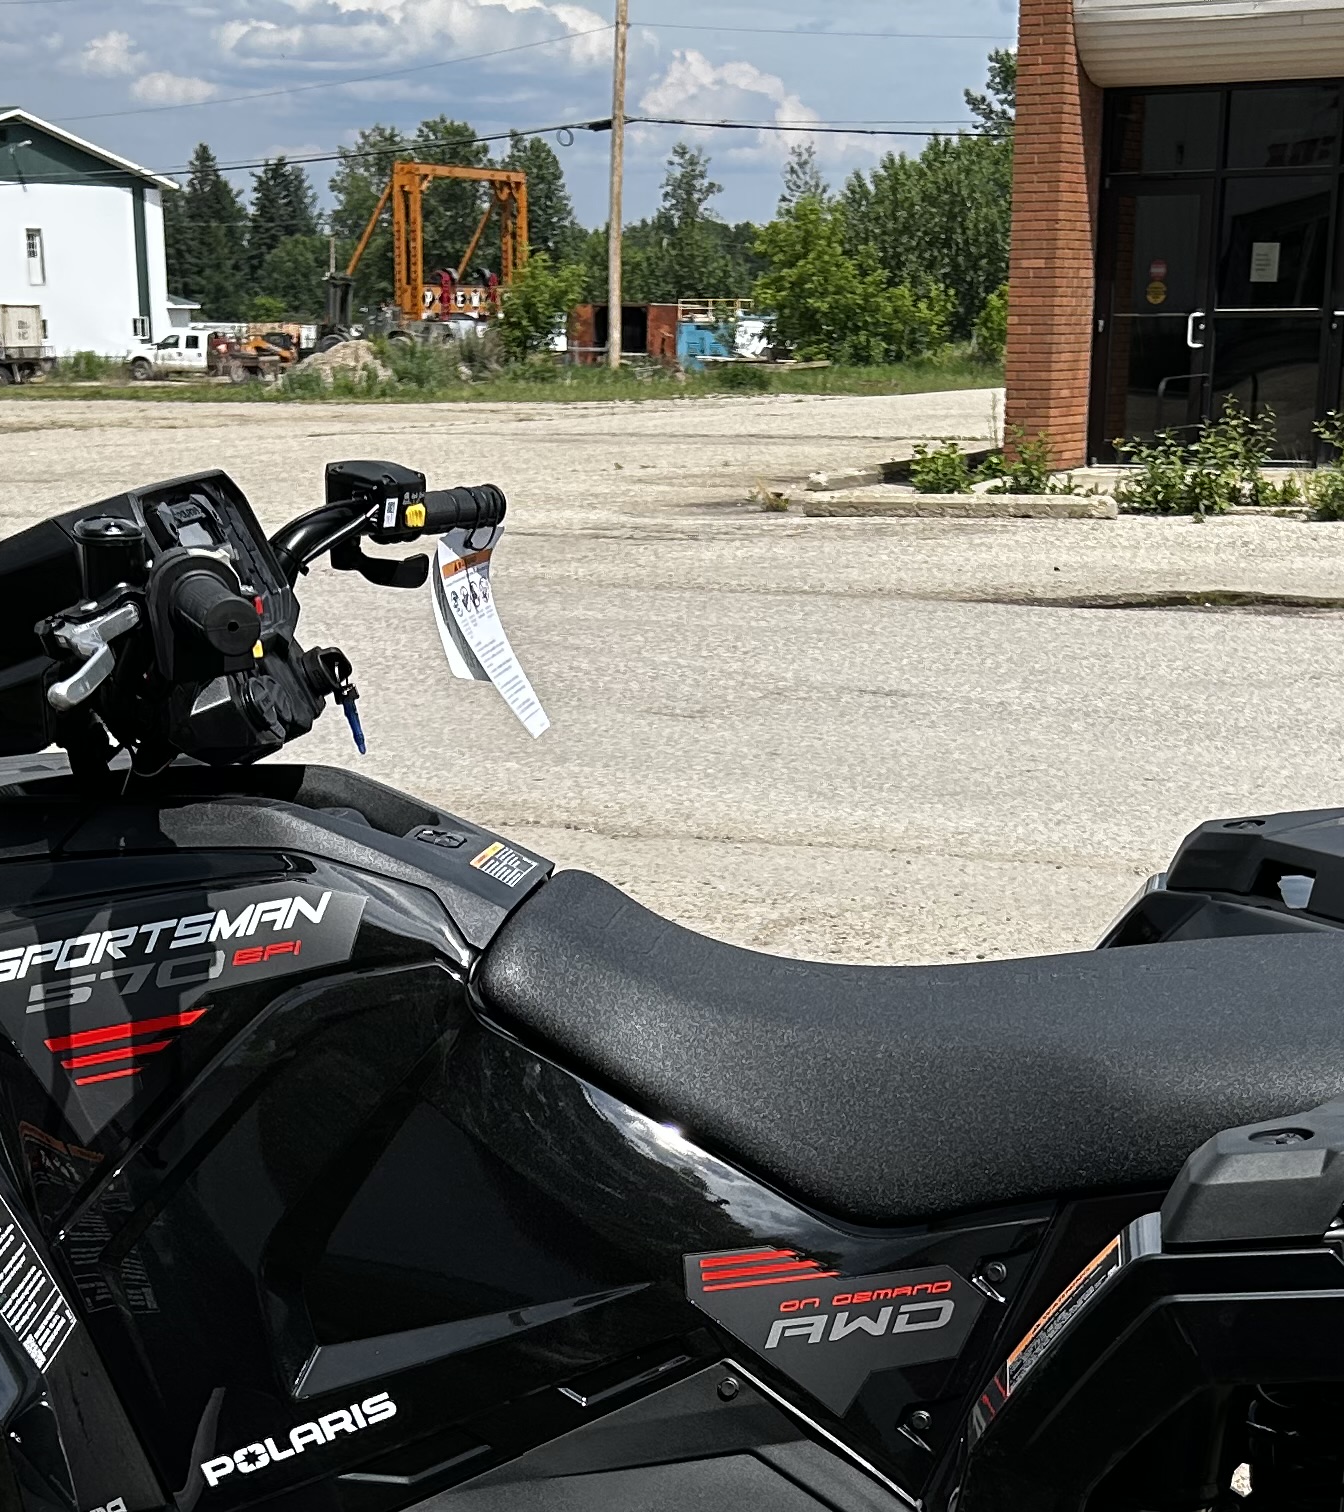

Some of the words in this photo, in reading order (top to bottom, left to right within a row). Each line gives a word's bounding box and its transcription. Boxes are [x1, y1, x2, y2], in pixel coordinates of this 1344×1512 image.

[25, 950, 226, 1014] 570
[232, 940, 302, 966] EFI
[764, 1300, 955, 1350] AWD
[779, 1298, 820, 1312] ON
[832, 1280, 952, 1307] DEMAND
[200, 1391, 397, 1487] POLARIS
